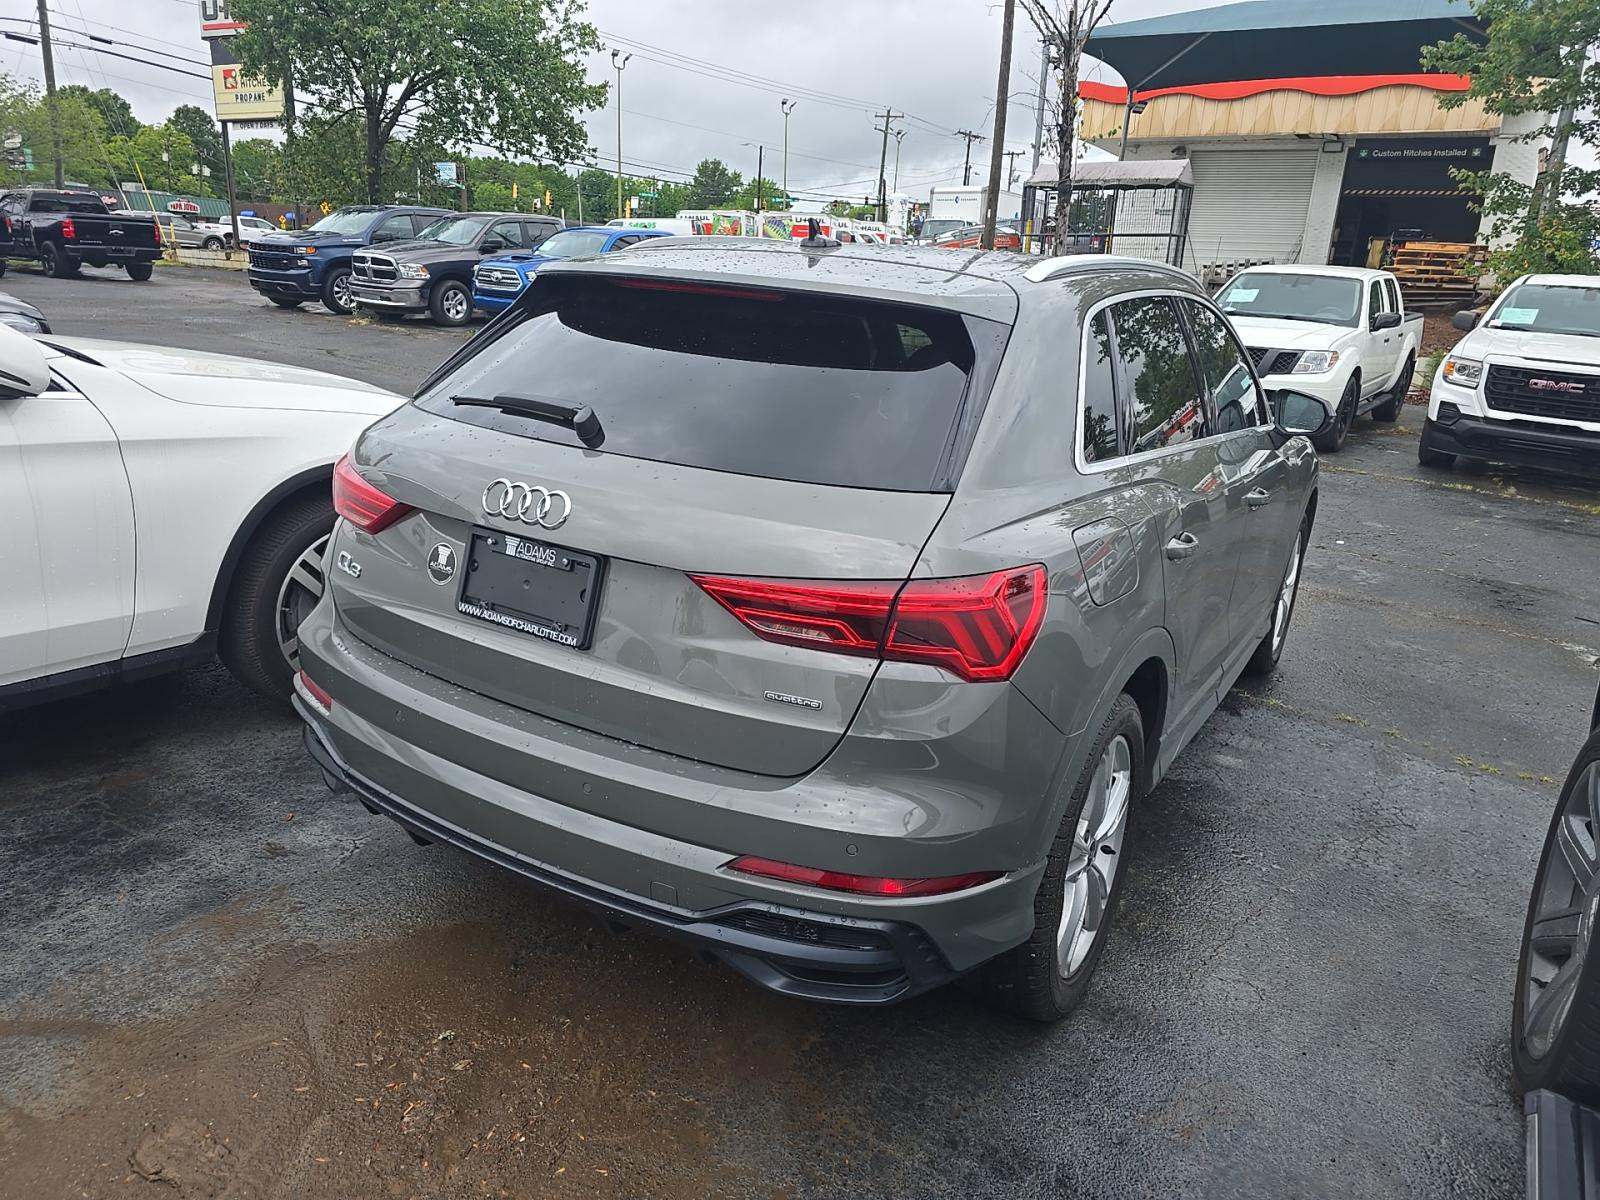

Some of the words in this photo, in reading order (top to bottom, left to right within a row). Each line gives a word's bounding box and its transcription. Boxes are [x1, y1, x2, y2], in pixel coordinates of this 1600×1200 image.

[240, 79, 271, 88] HITCHE
[235, 92, 266, 102] PROPANE
[1372, 149, 1402, 157] Custom
[1403, 149, 1432, 157] Hitches
[1434, 148, 1467, 156] Installed
[1529, 379, 1586, 394] GMC
[516, 541, 557, 563] ADAMS
[338, 551, 361, 577] Q3
[429, 560, 453, 575] ADAMS
[458, 601, 577, 646] WWW.ADAMSOFCHARLOTTE.COM
[766, 693, 819, 708] quattro
